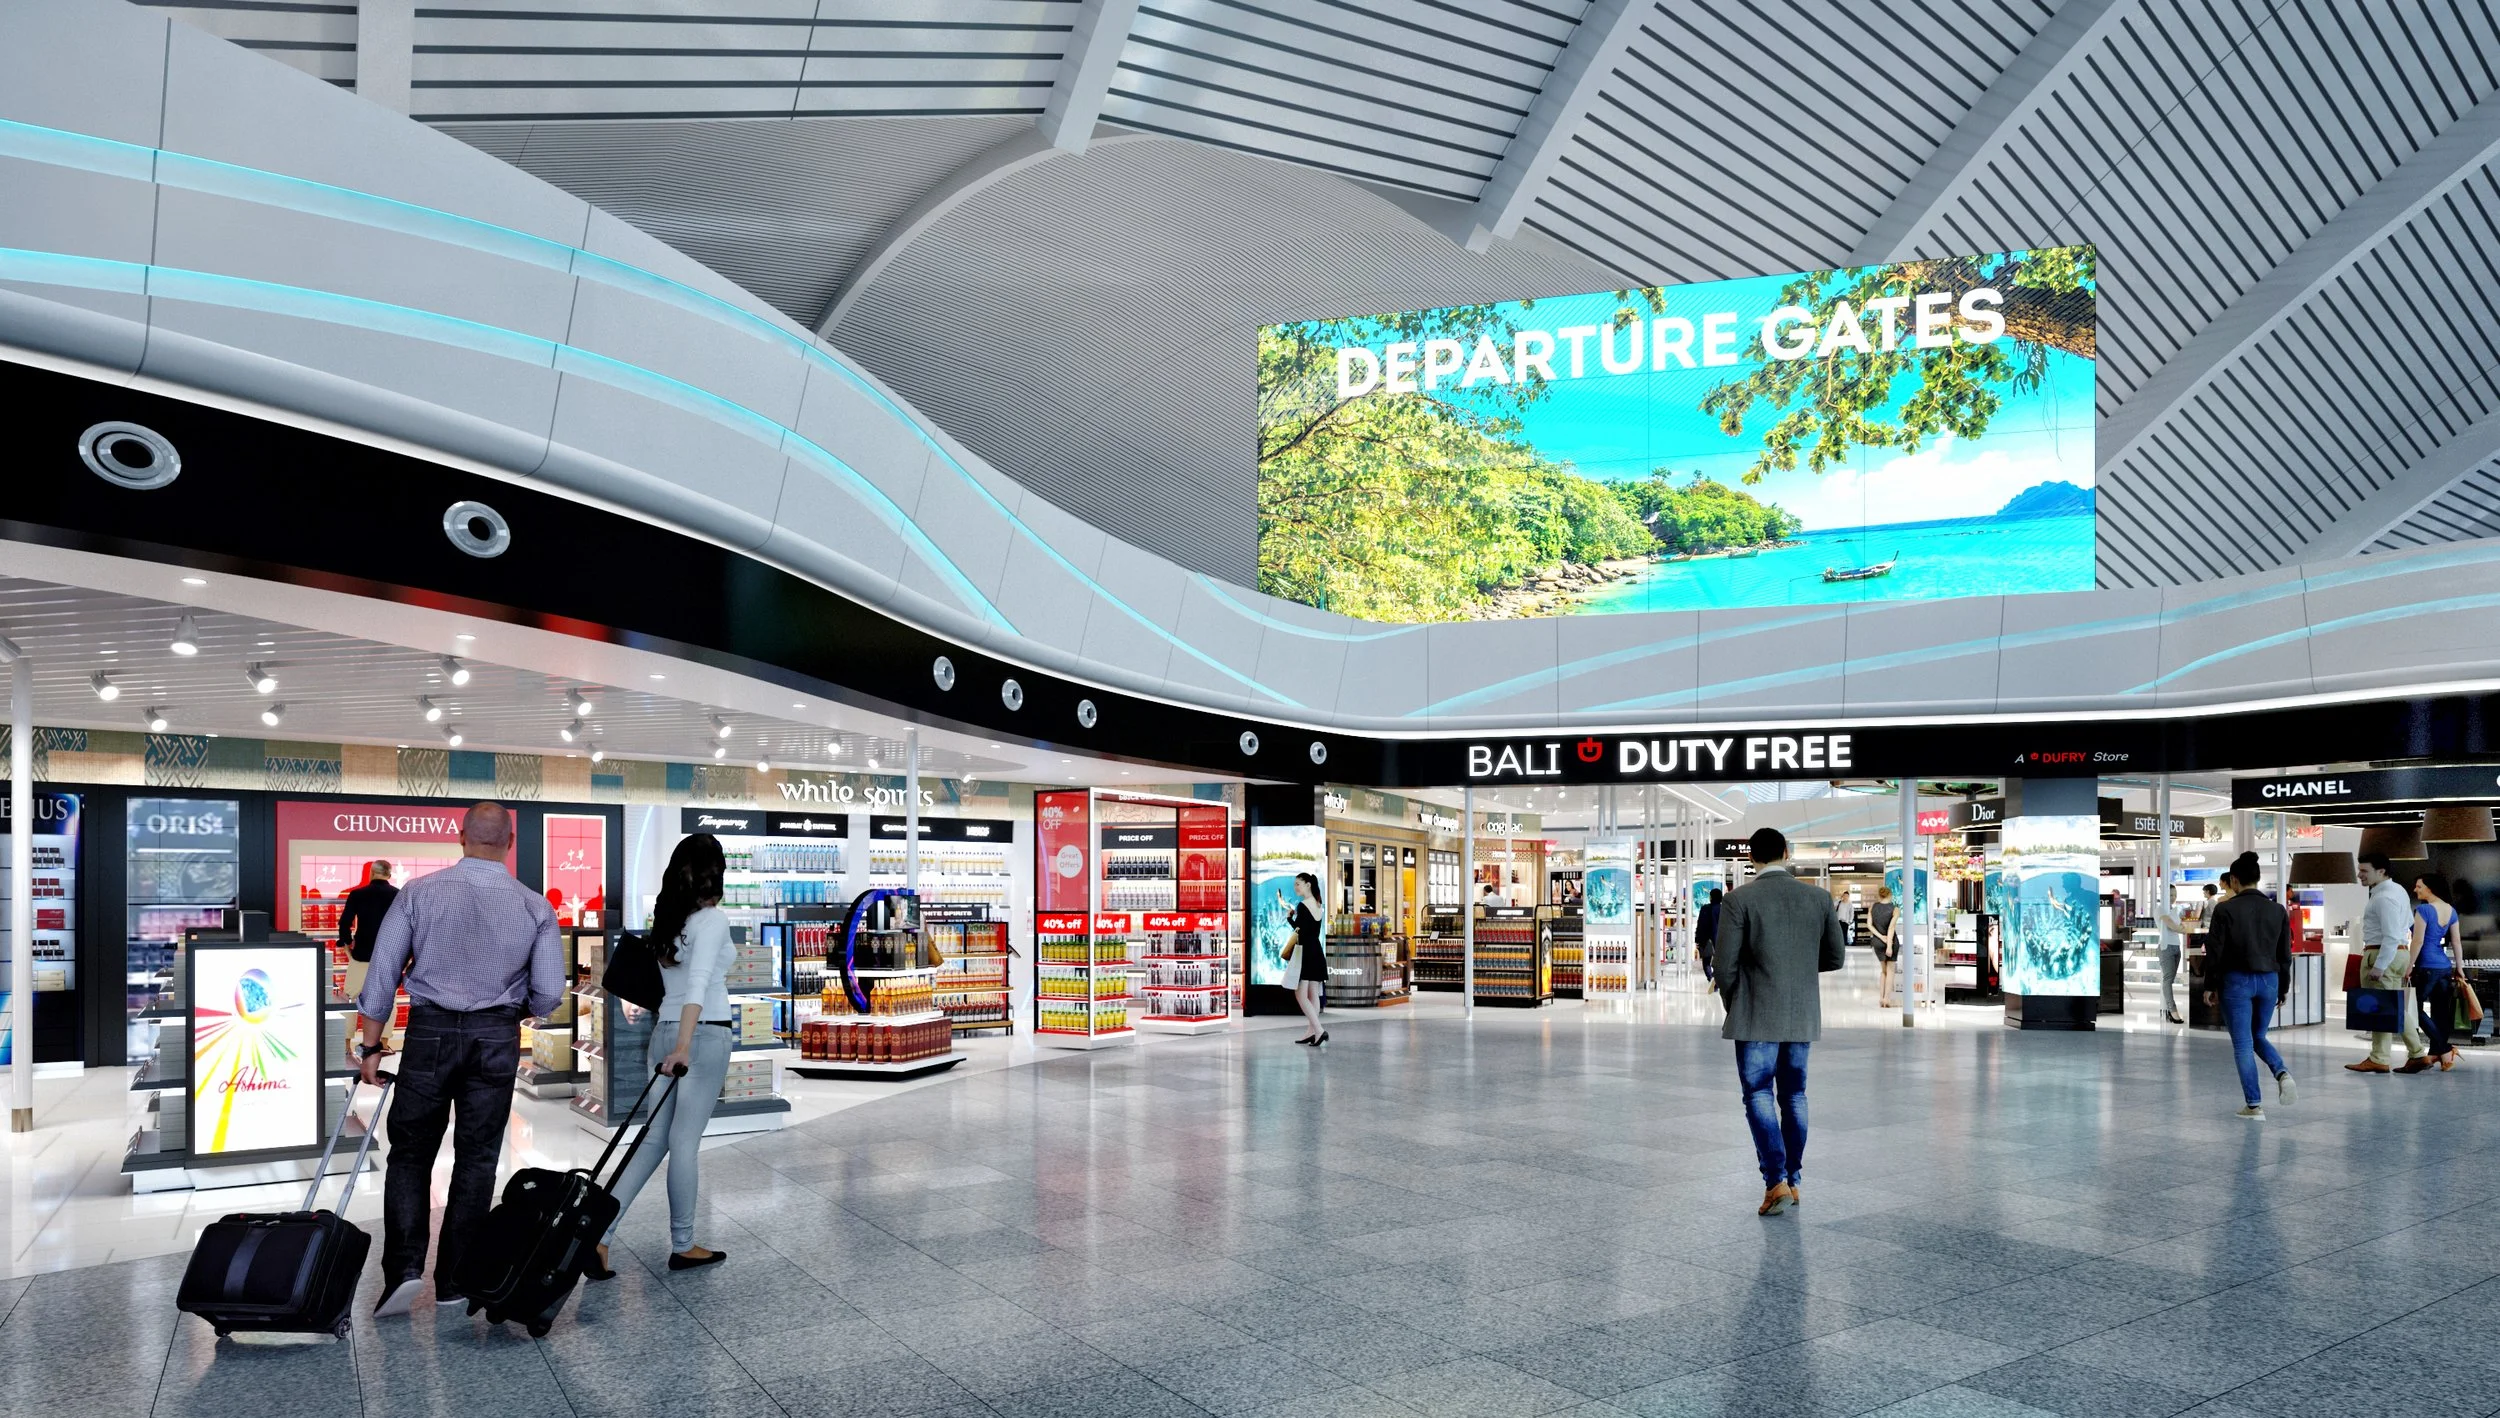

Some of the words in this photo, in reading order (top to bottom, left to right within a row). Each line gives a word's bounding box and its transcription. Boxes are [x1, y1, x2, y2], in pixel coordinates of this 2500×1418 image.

[1336, 311, 1738, 398] DEPARTURE
[1760, 286, 2008, 361] GATES
[1468, 743, 1562, 777] BALI
[1618, 737, 1734, 774] DUTY
[1745, 734, 1853, 770] FREE
[2014, 753, 2025, 764] A
[2042, 752, 2087, 763] DUFRY
[2092, 751, 2130, 762] Store
[776, 778, 854, 804] white
[2261, 780, 2352, 799] CHANEL
[1041, 806, 1064, 818] 40%
[1971, 803, 1996, 821] Dior
[333, 814, 460, 834] CHUNGHWA
[1042, 819, 1061, 830] OFF
[1486, 821, 1524, 836] cogac
[2134, 816, 2156, 832] ESTÉE
[2157, 818, 2185, 833] LDER
[1118, 834, 1140, 842] PRICE
[1139, 834, 1154, 842] OFF
[1043, 918, 1066, 930] 40%
[1066, 918, 1083, 930] off
[1095, 918, 1114, 930] 40%
[1113, 918, 1126, 930] off
[1149, 916, 1171, 928] 40%
[1171, 916, 1187, 928] off
[1198, 917, 1213, 927] 40%
[1212, 917, 1223, 927] off
[217, 1065, 292, 1094] Ashima
